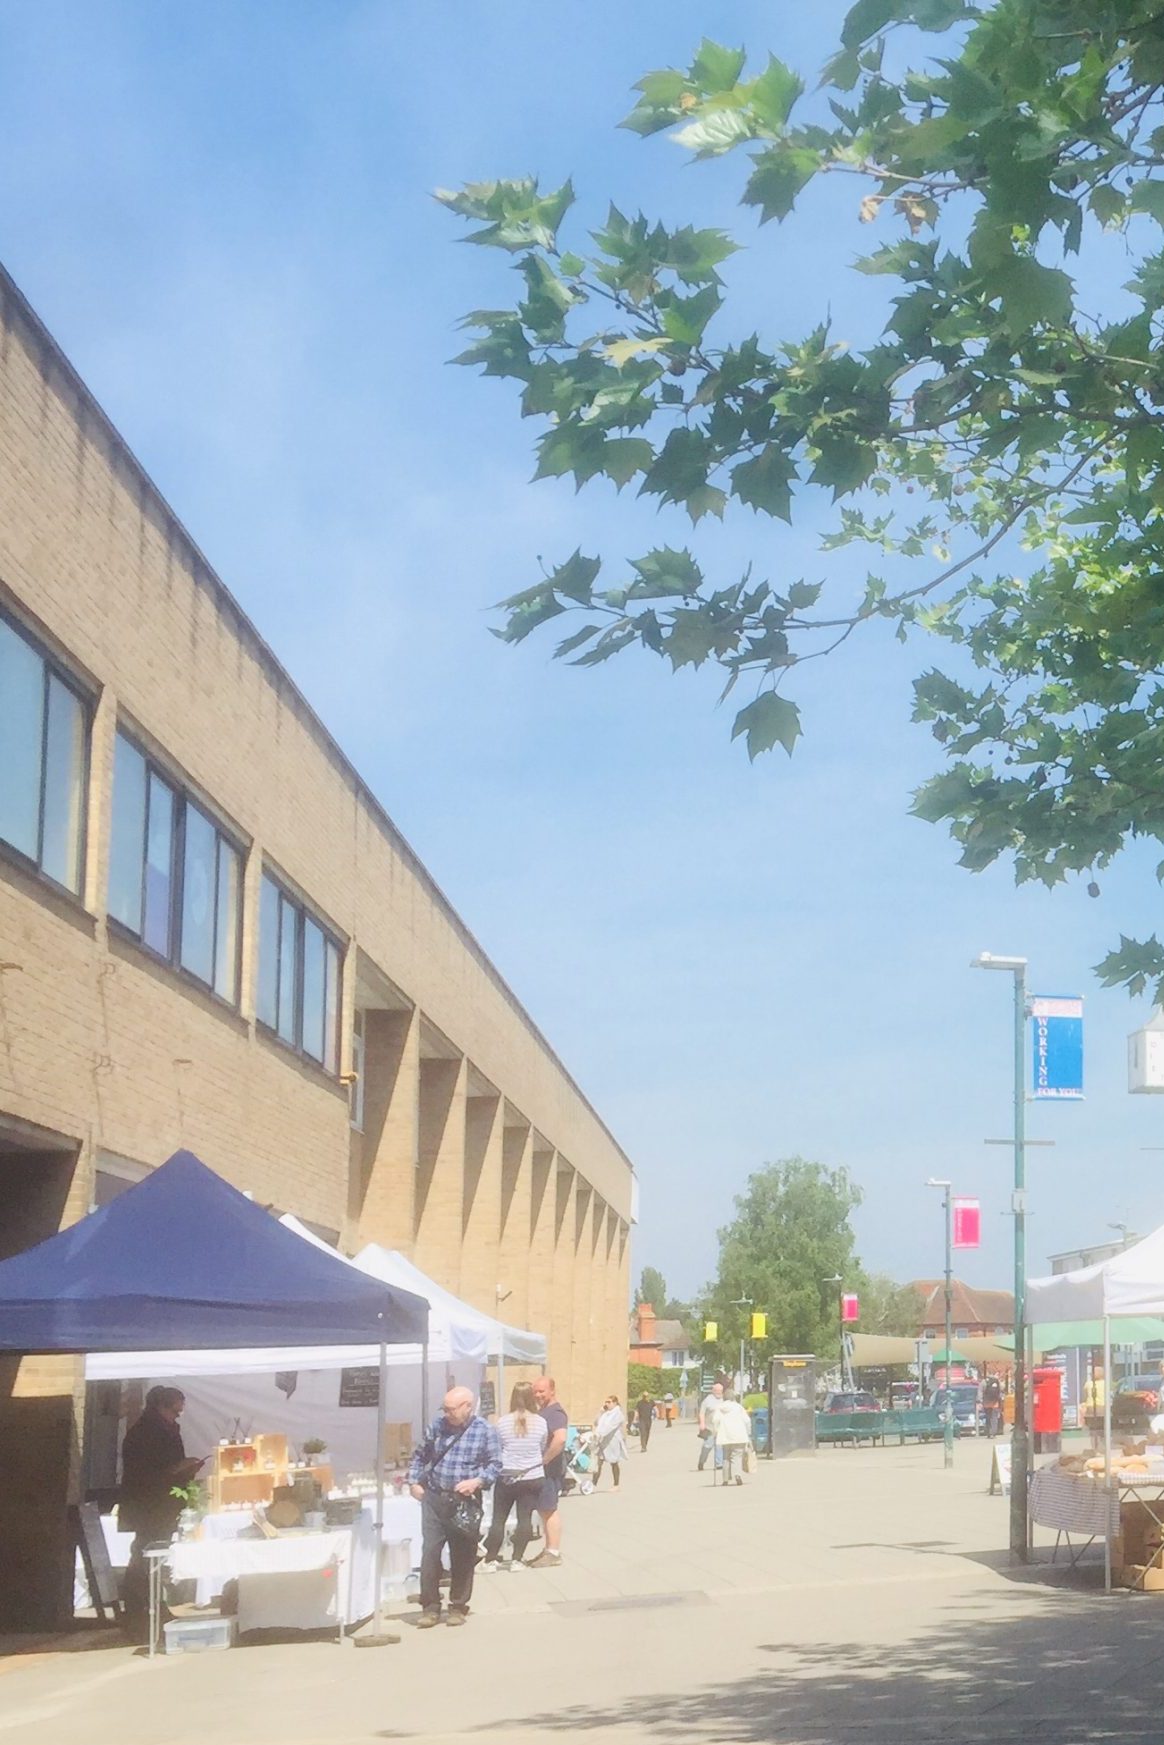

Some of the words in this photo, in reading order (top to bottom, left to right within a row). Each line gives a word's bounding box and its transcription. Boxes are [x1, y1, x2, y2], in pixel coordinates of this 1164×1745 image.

[1037, 1016, 1049, 1086] WORKING
[1037, 1087, 1057, 1097] FOR
[1058, 1087, 1081, 1097] YOU
